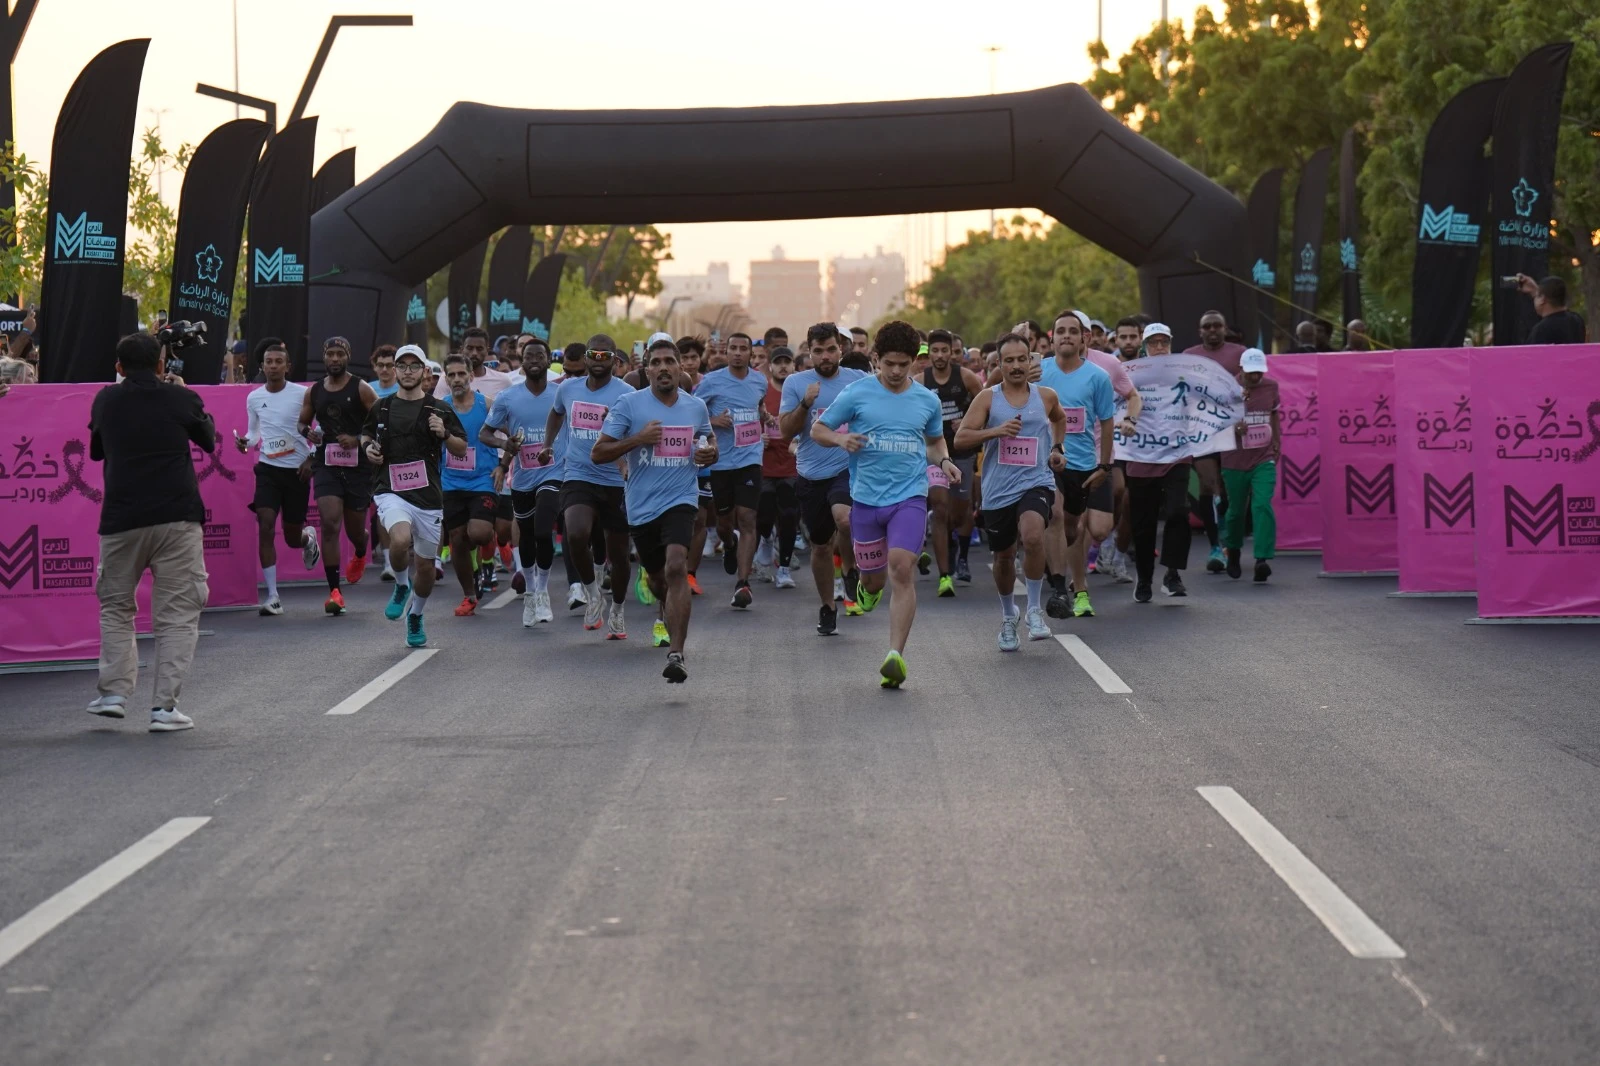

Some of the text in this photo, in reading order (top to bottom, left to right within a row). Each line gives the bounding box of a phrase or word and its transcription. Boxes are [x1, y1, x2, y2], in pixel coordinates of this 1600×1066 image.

[88, 223, 102, 233] نادي
[86, 237, 116, 247] مسافات
[180, 282, 210, 299] الرياضة
[578, 411, 599, 421] 1053
[268, 439, 286, 450] 1780
[663, 437, 687, 447] 1051
[1131, 431, 1169, 449] مجرد
[879, 440, 893, 452] PINK
[1006, 446, 1029, 456] 1211
[332, 451, 352, 459] 1555
[1496, 444, 1571, 462] وردية
[650, 457, 665, 467] PINK
[397, 471, 419, 481] 1324
[1568, 498, 1594, 512] نادي
[1571, 536, 1599, 545] MASAFAT
[44, 539, 69, 554] نادي
[858, 549, 882, 560] 1156
[43, 558, 93, 572] مسافات
[45, 576, 91, 587] MASAFAT CLUB
